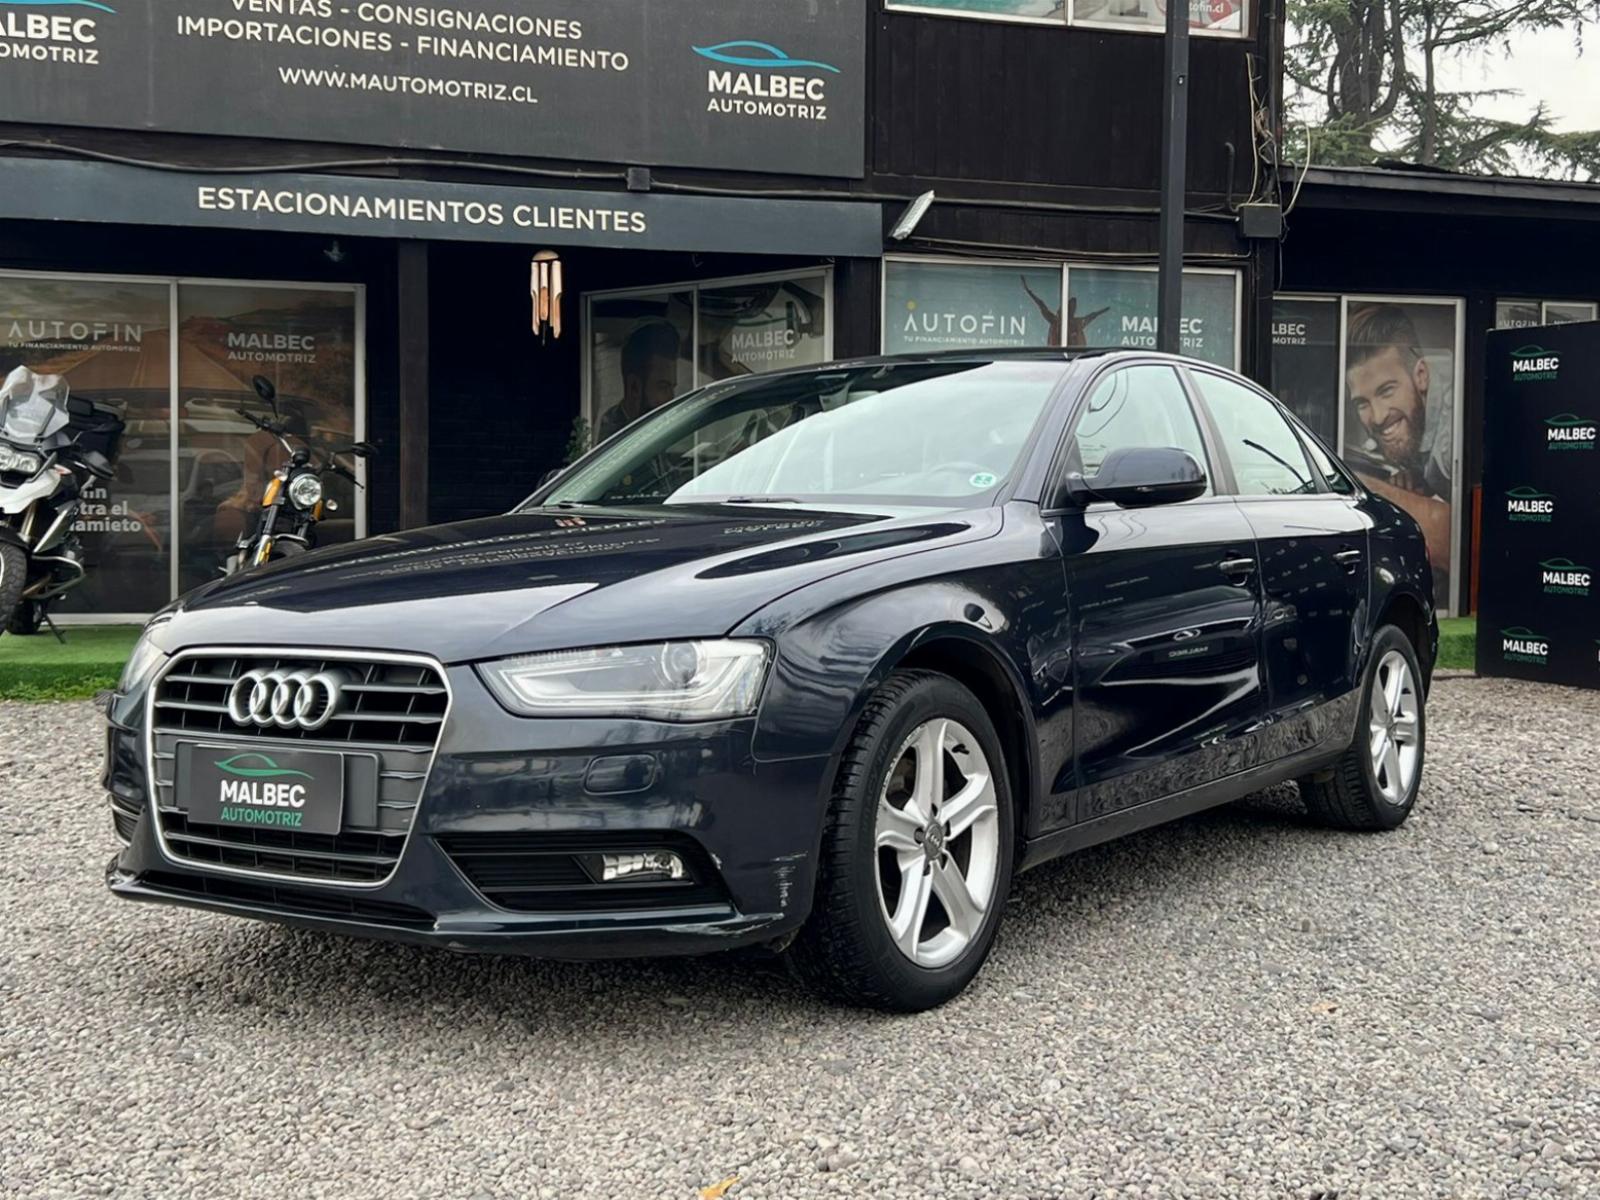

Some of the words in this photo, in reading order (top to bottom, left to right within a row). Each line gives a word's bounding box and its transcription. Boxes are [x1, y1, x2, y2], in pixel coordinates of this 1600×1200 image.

[0, 12, 96, 43] LBEC
[232, 0, 332, 18] VENTAS
[357, 2, 582, 40] CONSIGNACIONES
[0, 42, 99, 65] OMOTRIZ
[177, 15, 392, 52] IMPORTACIONES
[417, 35, 629, 71] FINANCIAMIENTO
[278, 66, 538, 103] WWW.MAUTOMOTRIZ.CL
[708, 70, 825, 101] MALBEC
[707, 98, 827, 120] AUTOMOTRIZ
[198, 186, 504, 225] ESTACIONAMIENTOS
[512, 205, 646, 233] CLIENTES
[8, 320, 142, 342] AUTOFIN
[903, 312, 1026, 336] AUTOFIN
[227, 332, 315, 351] MALBEC
[731, 329, 795, 350] MALBEC
[227, 350, 317, 364] AUTOMOTRIZ
[731, 348, 796, 363] AUTOMOTRIZ
[1513, 358, 1559, 372] MALBEC
[1547, 427, 1596, 441] MALBEC
[79, 501, 106, 516] tra
[111, 500, 128, 516] el
[1507, 500, 1553, 513] MALBEC
[1542, 571, 1591, 587] MALBEC
[1503, 639, 1549, 656] MALBEC
[220, 780, 306, 808] MALBEC
[220, 807, 303, 827] AUTOMOTRIZ
